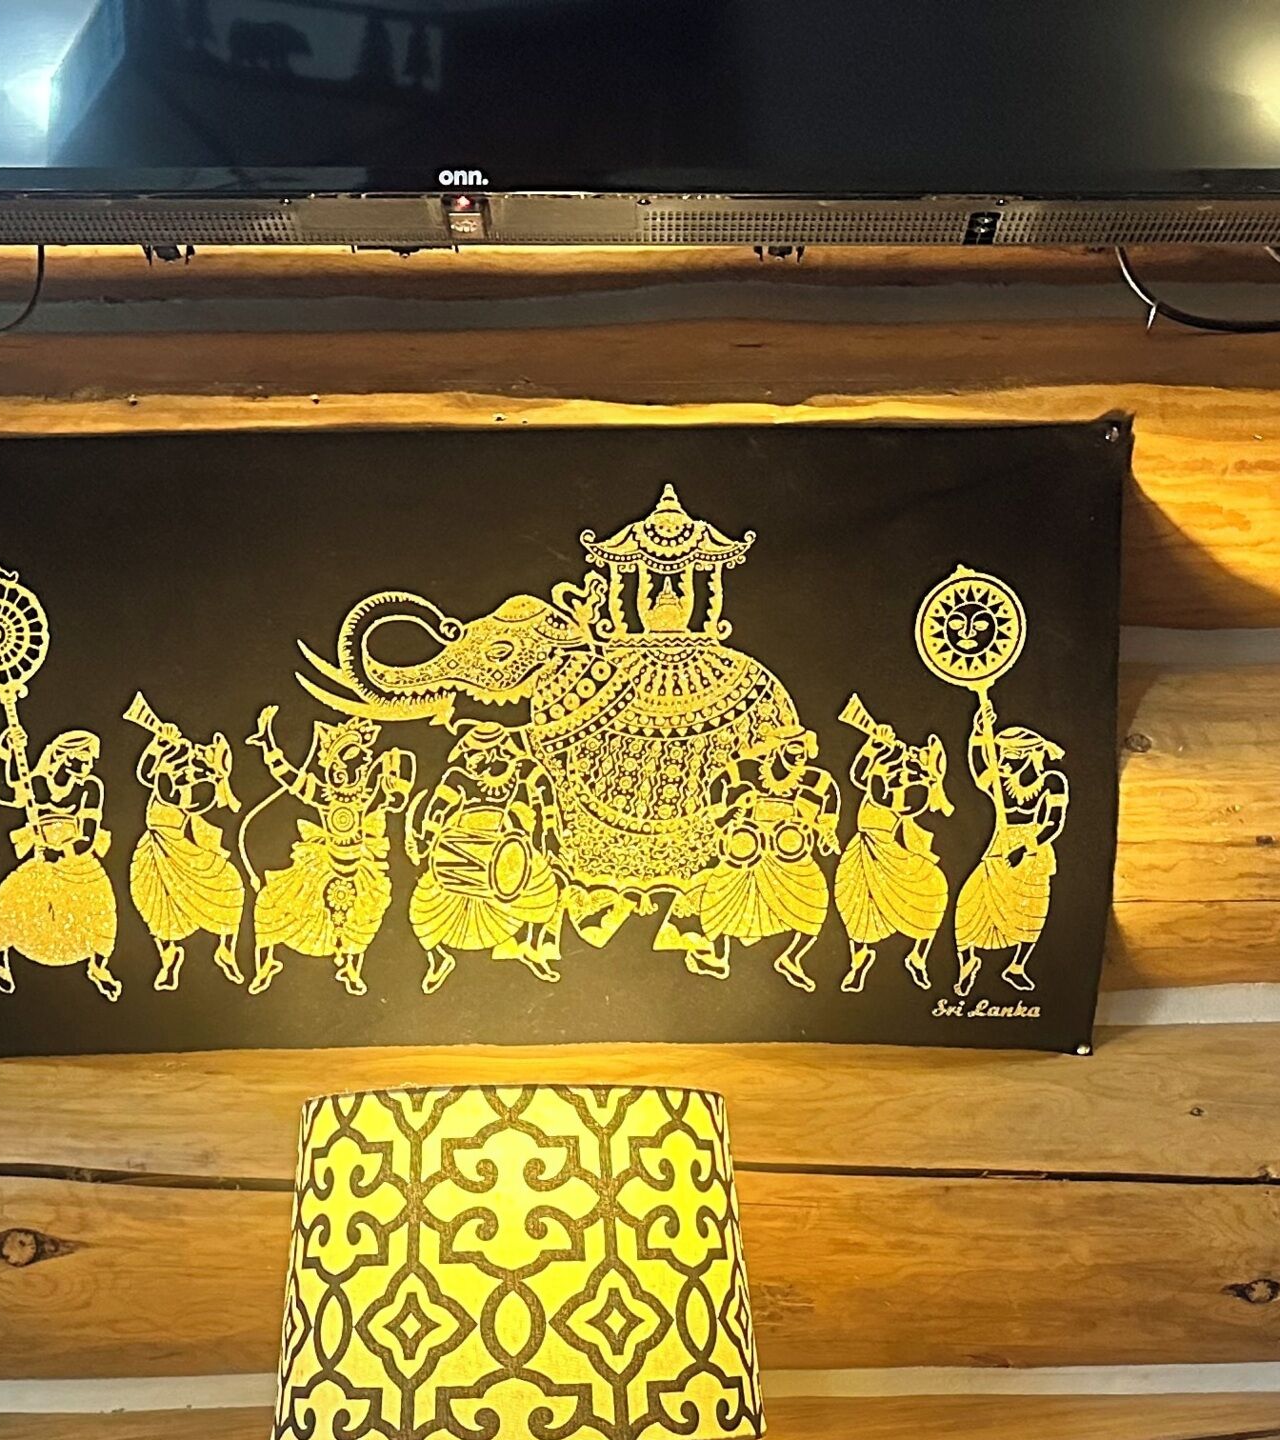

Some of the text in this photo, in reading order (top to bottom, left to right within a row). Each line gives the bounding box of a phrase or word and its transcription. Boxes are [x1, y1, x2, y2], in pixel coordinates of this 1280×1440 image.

[438, 169, 490, 186] onn.
[932, 998, 1042, 1018] Sri Lanka
